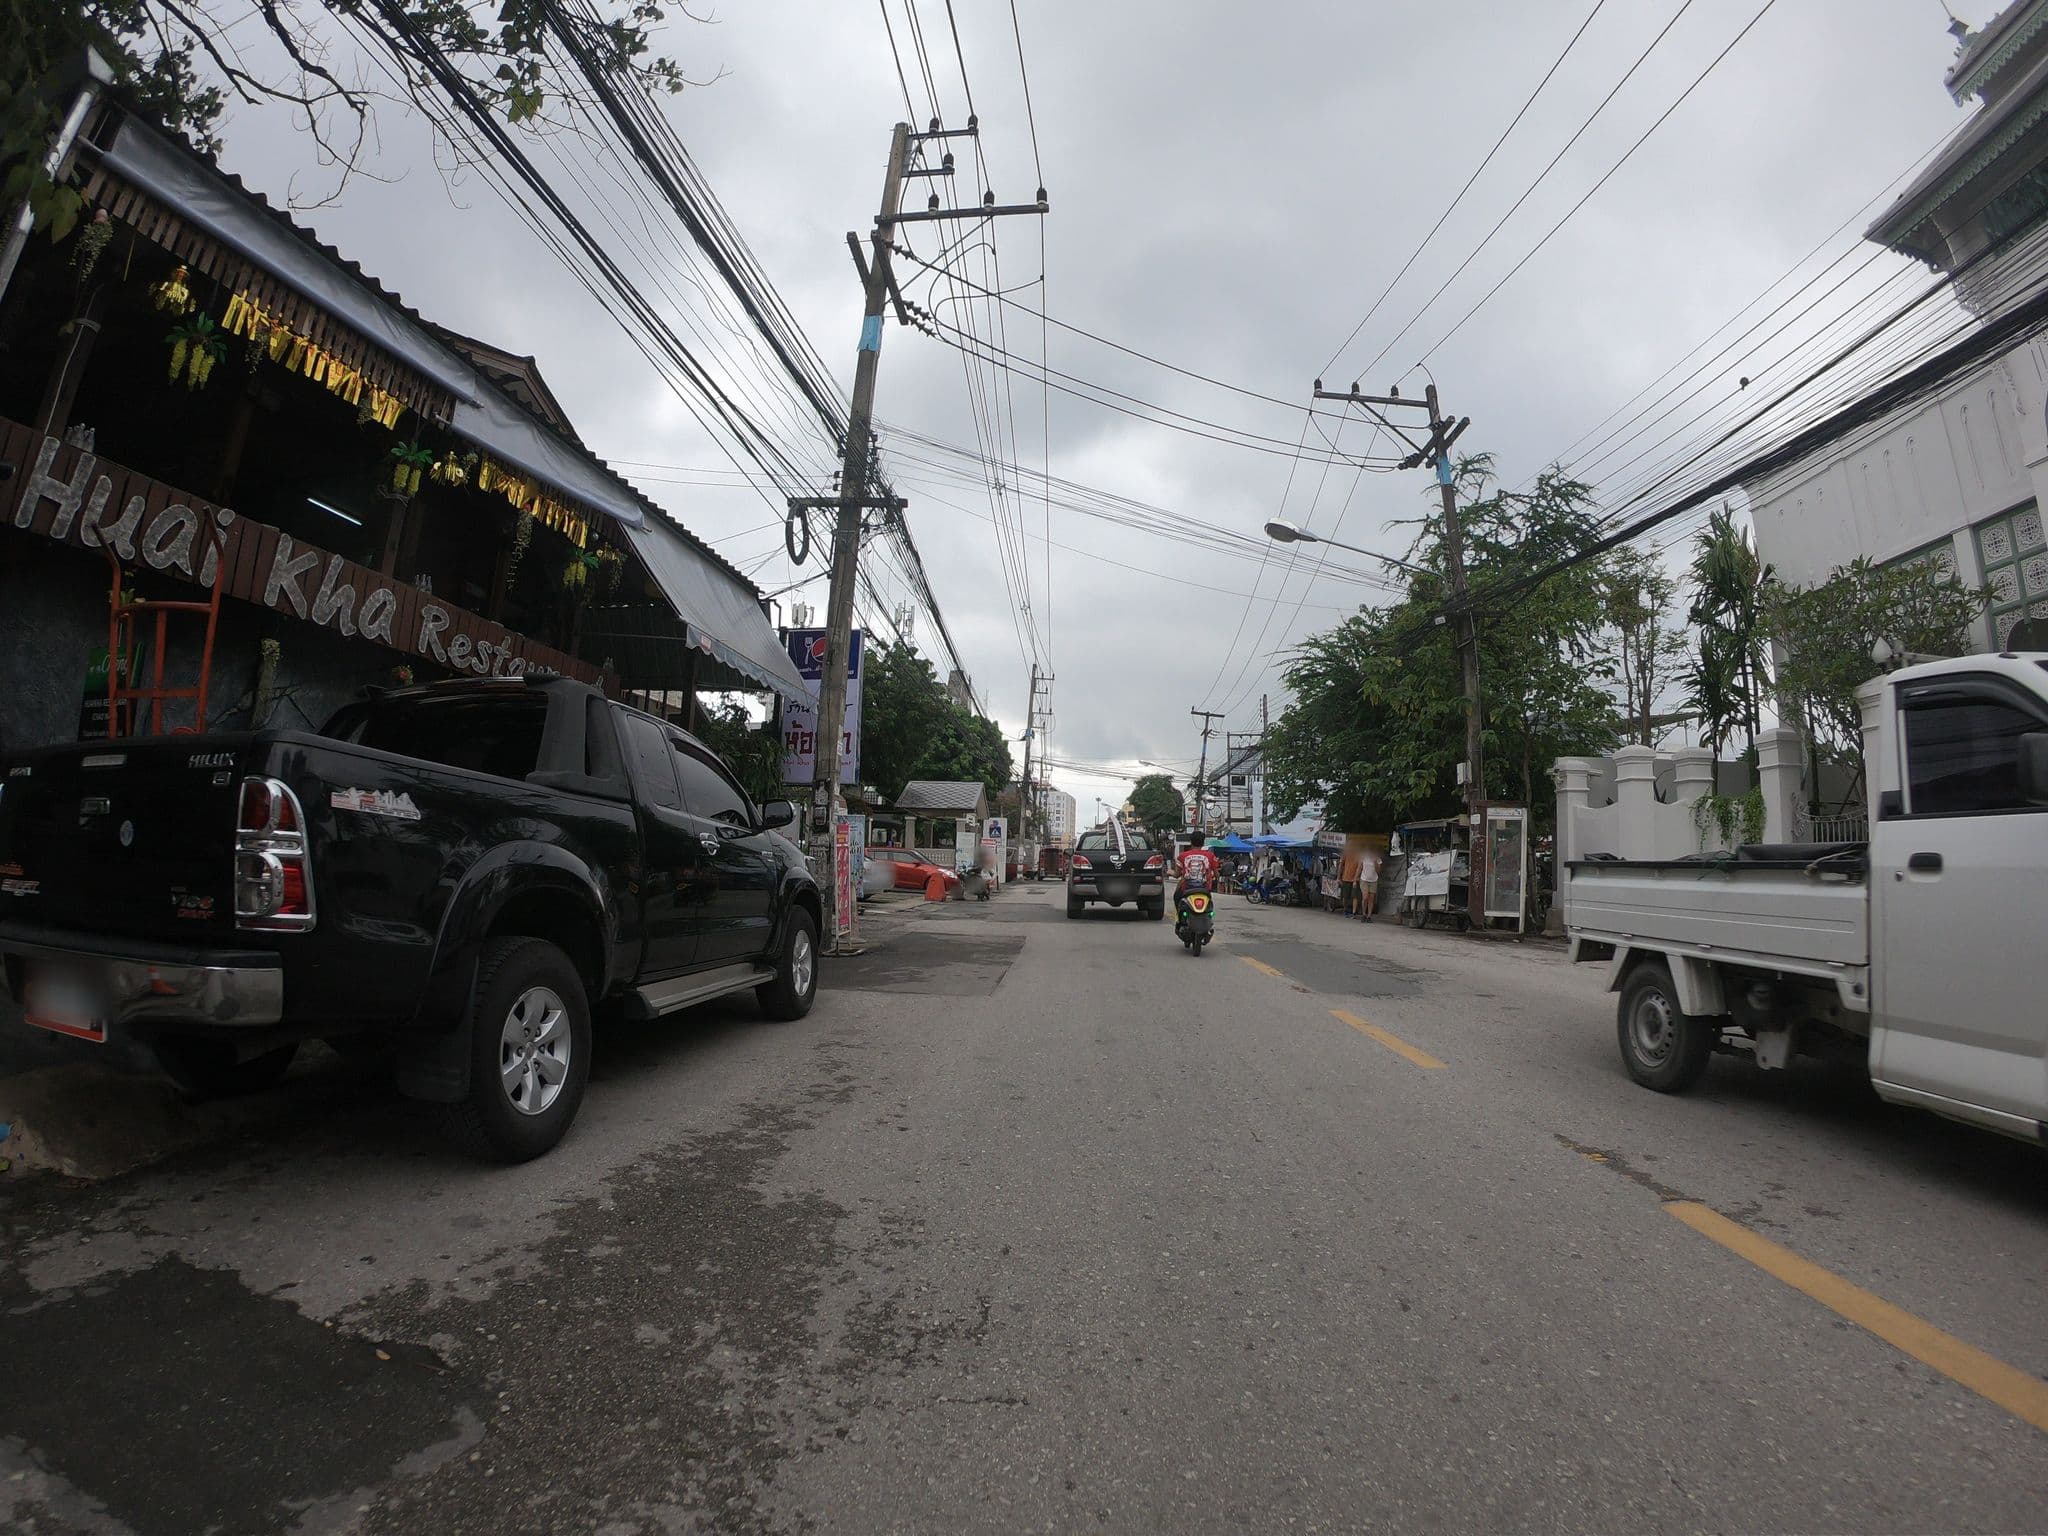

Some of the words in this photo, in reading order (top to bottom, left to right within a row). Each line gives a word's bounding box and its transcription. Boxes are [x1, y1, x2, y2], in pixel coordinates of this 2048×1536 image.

[15, 437, 236, 588] Huai
[264, 534, 397, 645] Kha
[188, 752, 236, 769] HILUX
